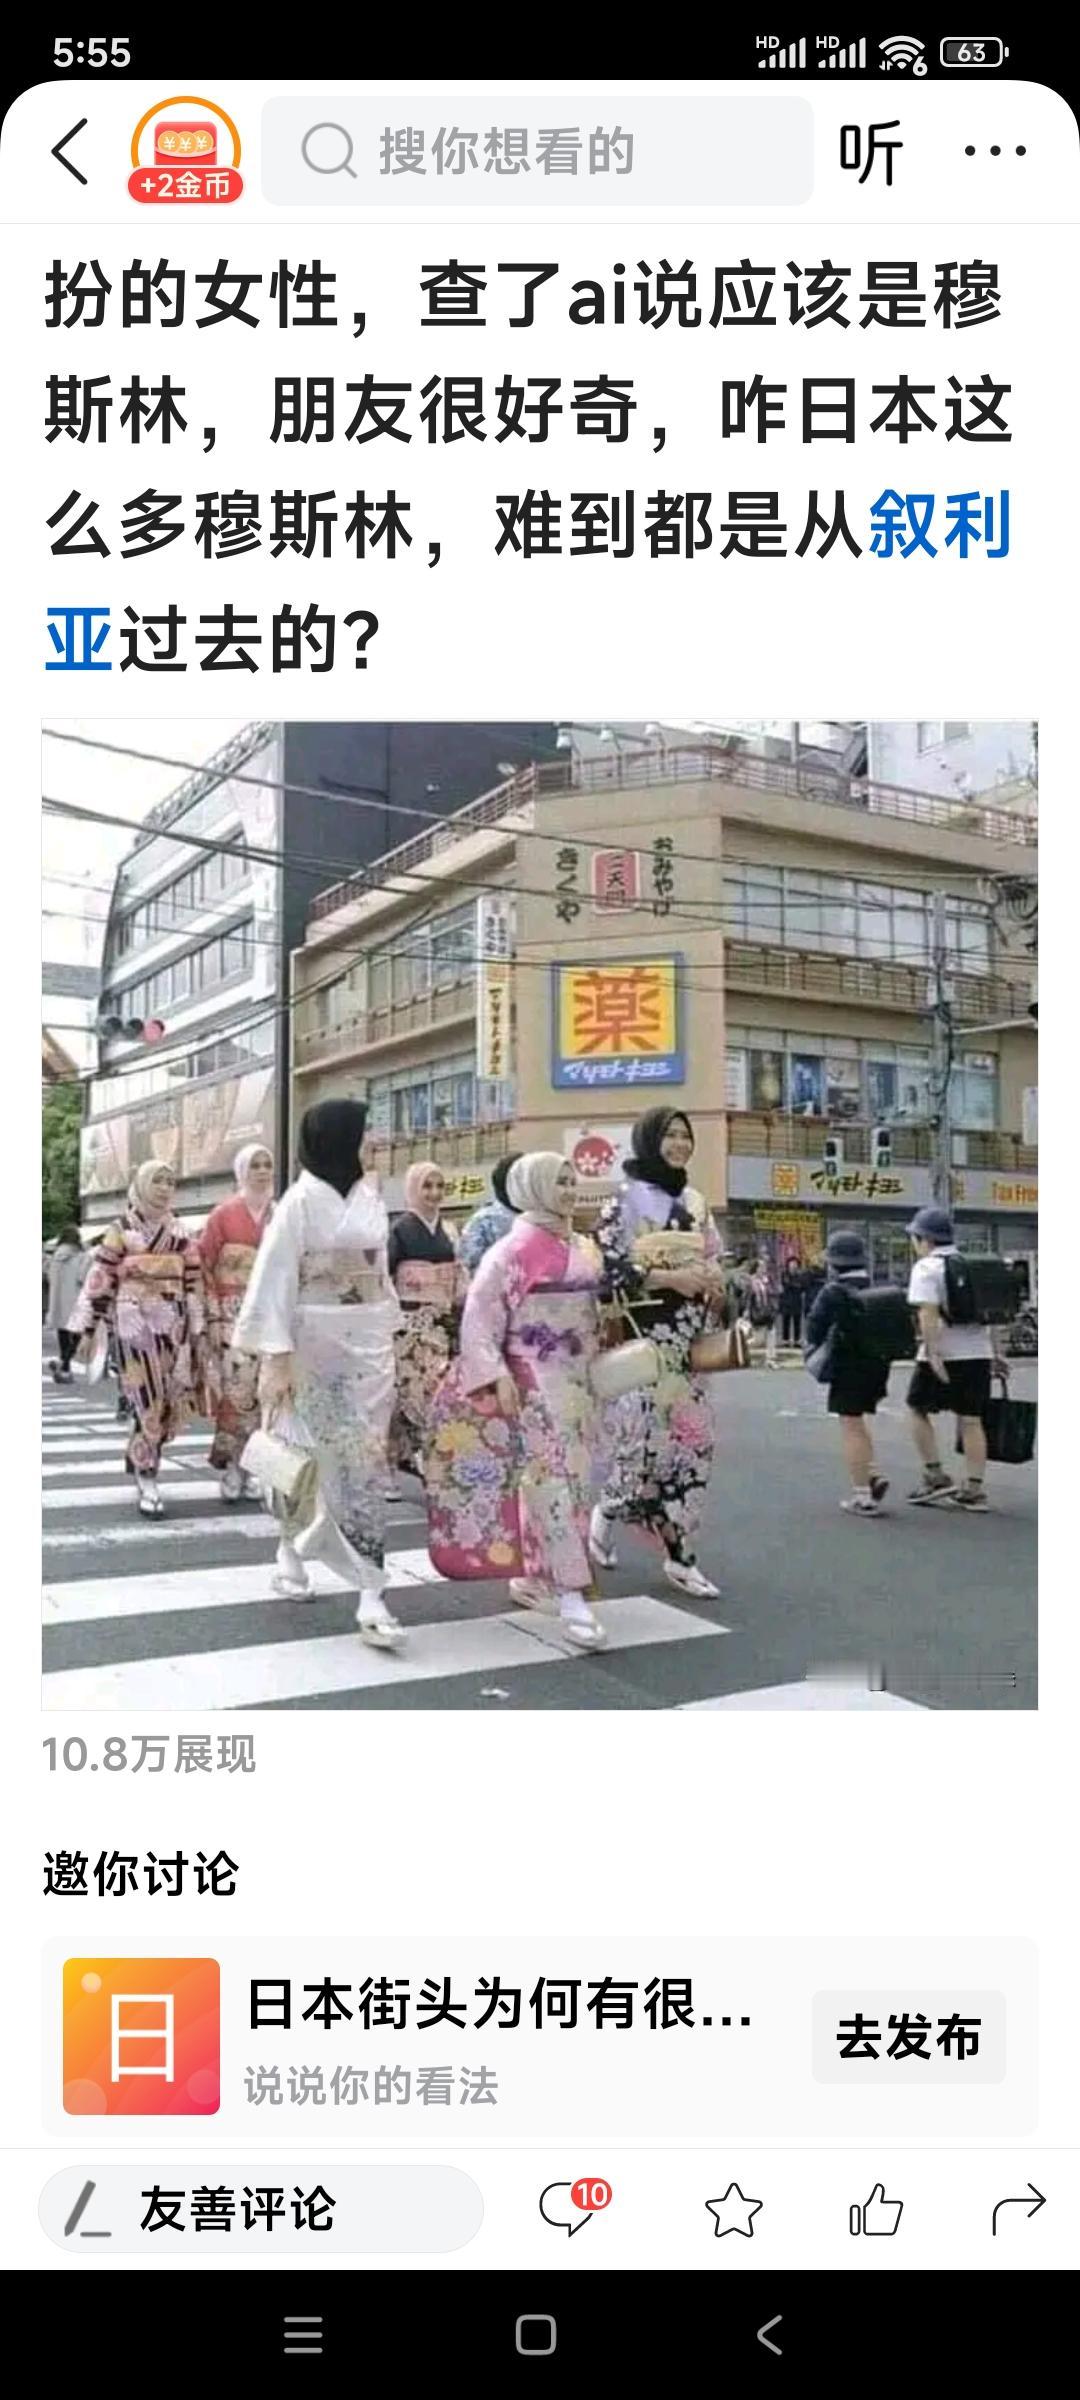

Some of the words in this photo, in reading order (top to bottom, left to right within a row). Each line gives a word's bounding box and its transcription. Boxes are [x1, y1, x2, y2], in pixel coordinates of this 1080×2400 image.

[53, 37, 132, 68] 5:55
[755, 35, 780, 49] HD
[815, 35, 840, 49] HD
[957, 43, 986, 63] 63
[379, 125, 634, 176] 搜你想看的
[839, 119, 905, 188] 听
[140, 170, 231, 200] +2金币
[556, 848, 581, 924] きくや
[572, 966, 660, 1055] 薬
[562, 1058, 672, 1085] マツモトキヨシ
[42, 1734, 257, 1774] 10.8万展现
[42, 1849, 240, 1898] 邀你讨论
[110, 1992, 175, 2083] 日
[835, 2012, 982, 2061] 去发布
[243, 2064, 499, 2106] 说说你的看法
[139, 2184, 337, 2233] 友善评论
[577, 2182, 608, 2207] 10
